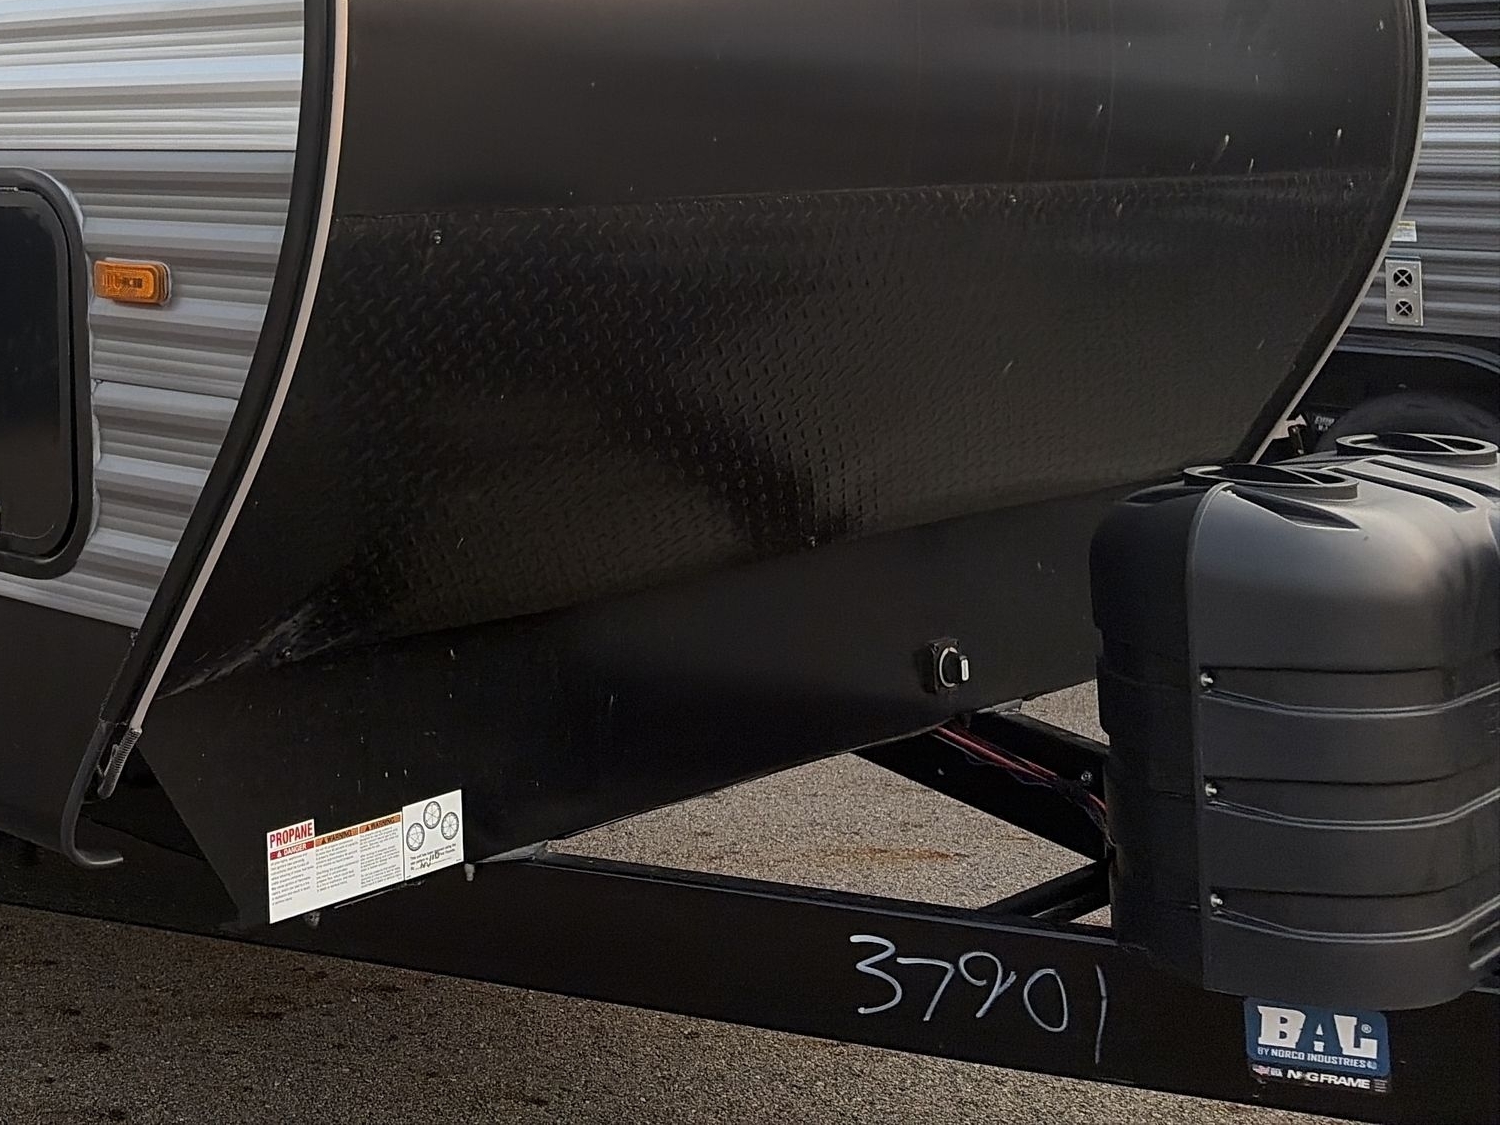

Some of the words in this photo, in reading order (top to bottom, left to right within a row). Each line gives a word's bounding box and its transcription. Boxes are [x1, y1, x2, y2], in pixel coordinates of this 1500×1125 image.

[269, 822, 313, 849] PROPANE
[283, 843, 307, 856] DANGER
[849, 934, 1108, 1065] 37901
[1257, 1047, 1269, 1056] BY
[1270, 1048, 1305, 1060] NORCO
[1307, 1053, 1367, 1068] INDUSTRIES
